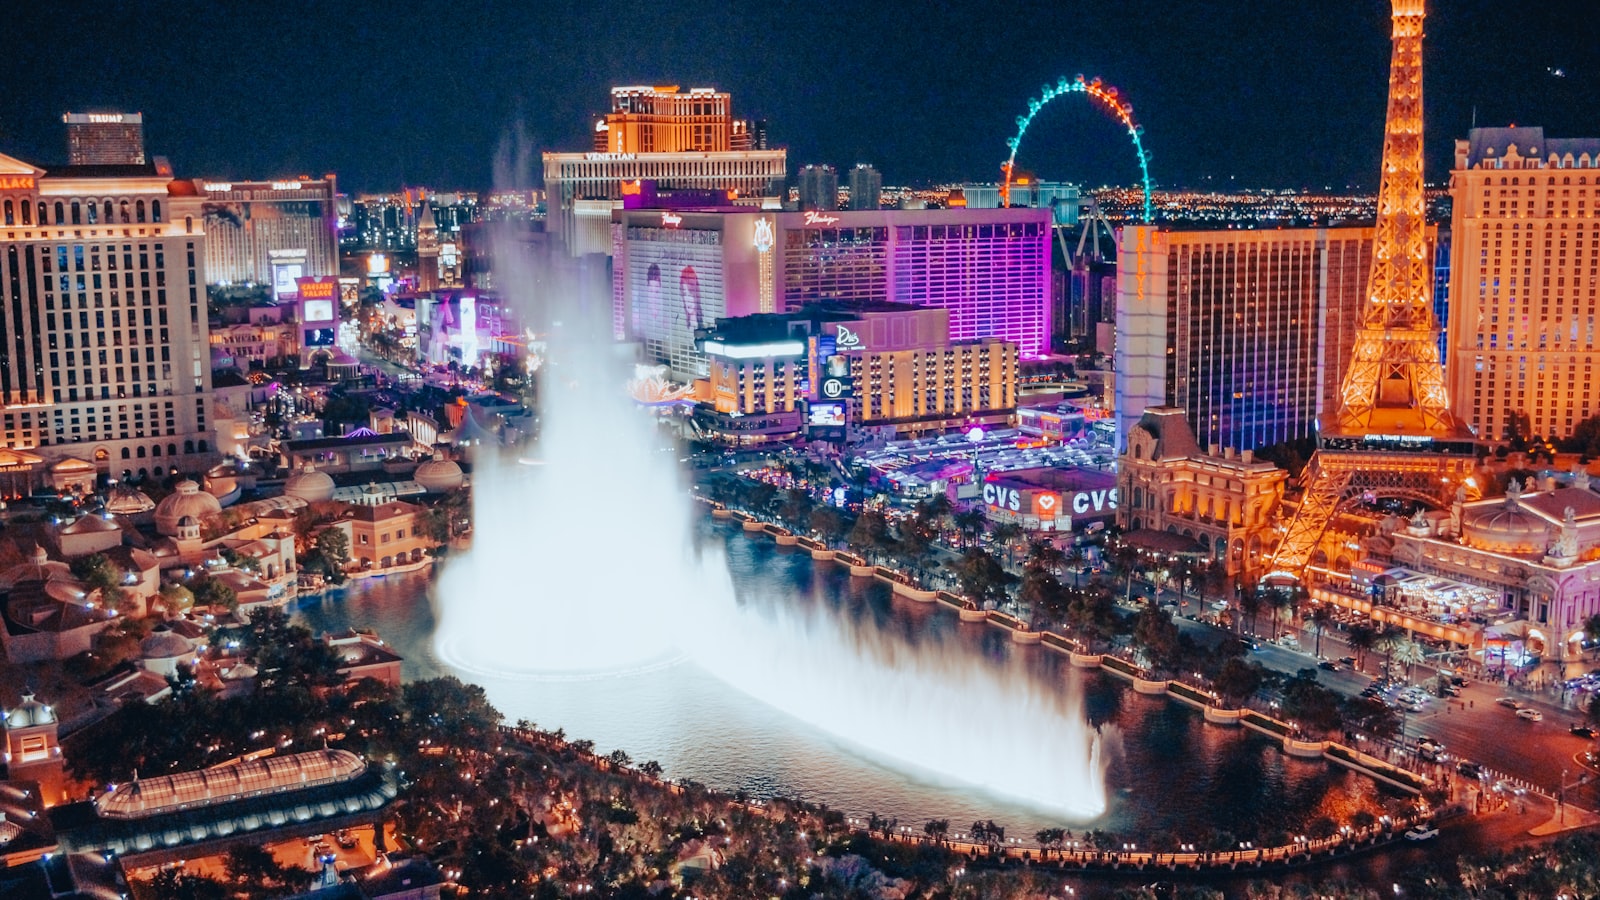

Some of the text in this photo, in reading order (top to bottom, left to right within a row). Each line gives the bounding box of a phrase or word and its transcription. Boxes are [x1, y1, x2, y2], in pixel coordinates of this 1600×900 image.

[88, 114, 123, 123] TRUMP
[586, 153, 635, 161] VENETIAN
[0, 177, 34, 189] LACE
[301, 282, 333, 290] CAESARS
[303, 289, 332, 297] PALACE
[983, 483, 1020, 511] CVS
[1073, 488, 1118, 514] CVS
[1366, 563, 1384, 573] PARK
